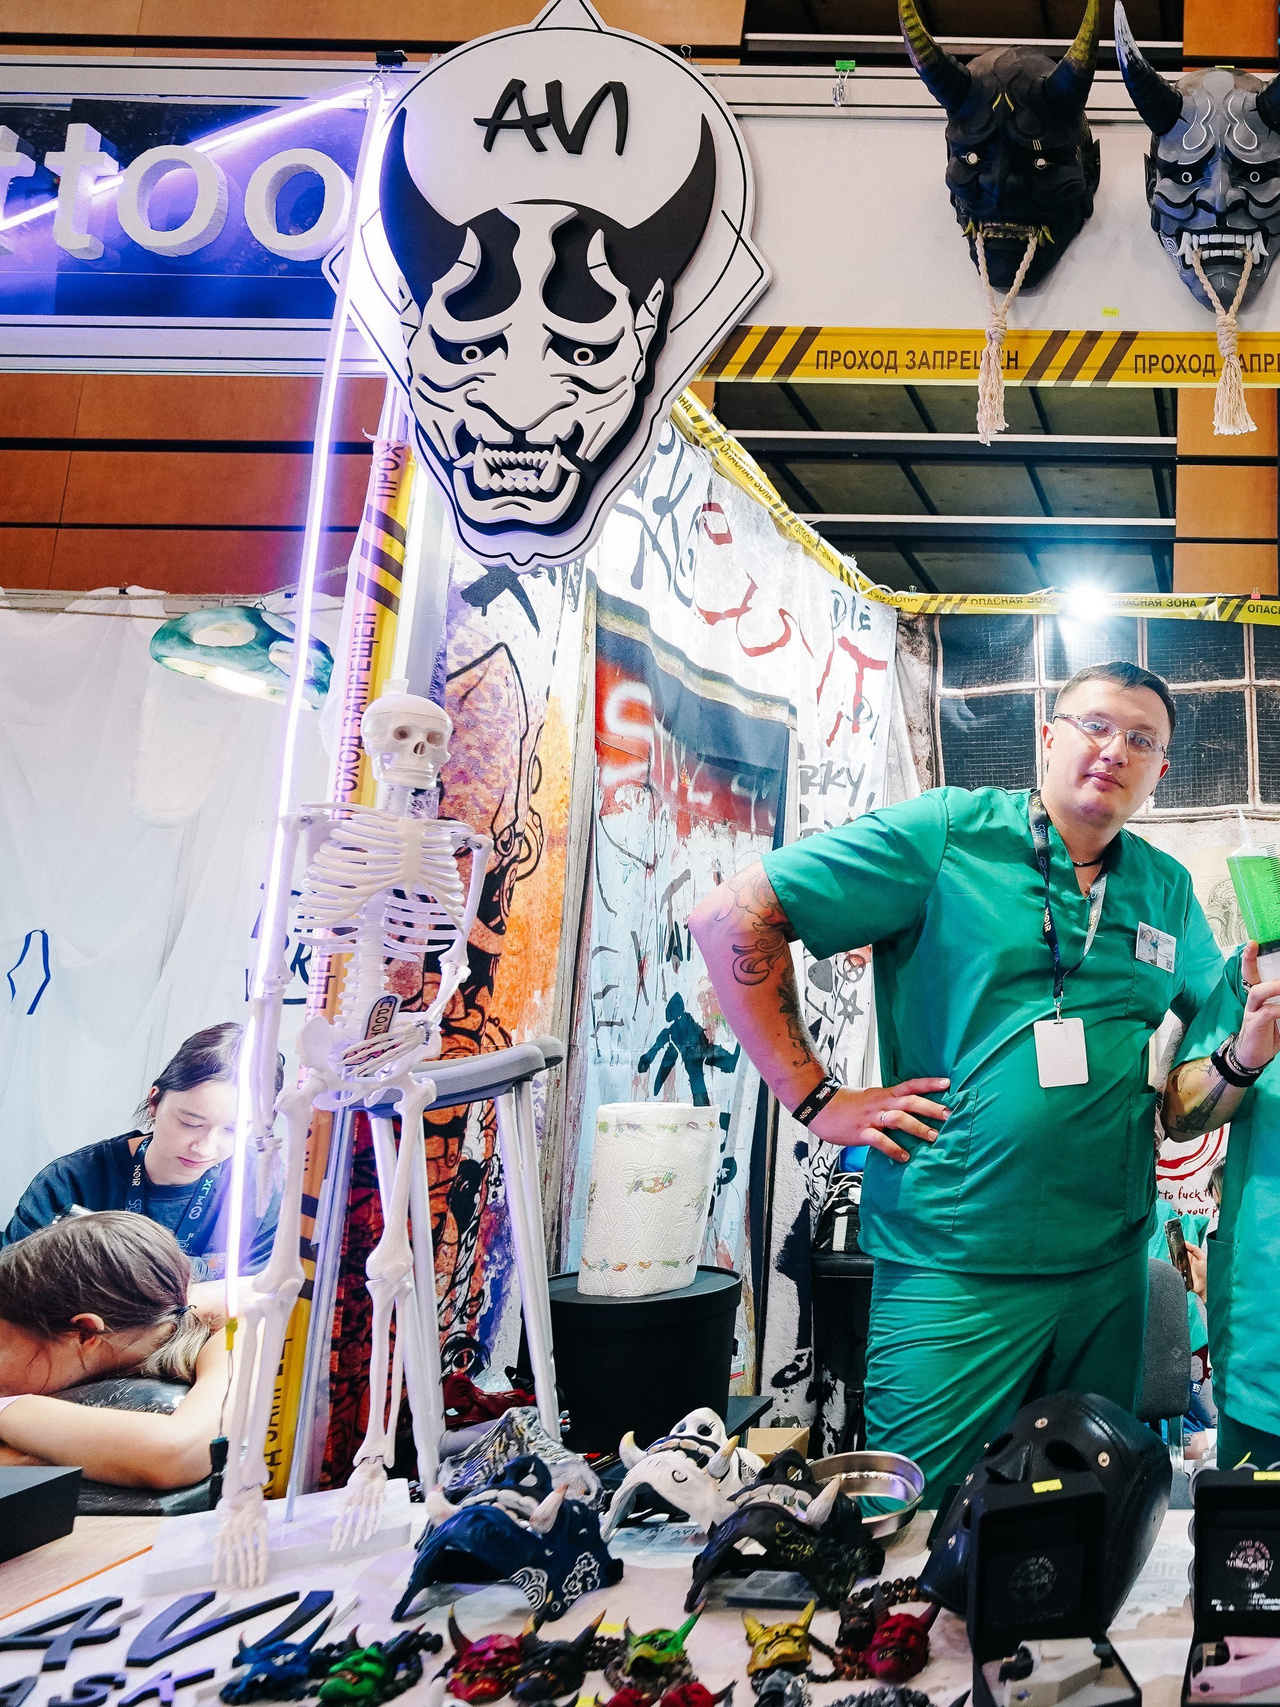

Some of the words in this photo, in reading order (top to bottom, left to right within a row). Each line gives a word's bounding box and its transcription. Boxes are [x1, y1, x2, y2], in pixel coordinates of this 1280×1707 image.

[815, 349, 899, 374] ПРОХОД
[1134, 353, 1217, 377] ПРОХОД
[1165, 599, 1197, 609] ЗОНА
[1178, 1185, 1204, 1203] fuck
[1187, 1207, 1209, 1216] your
